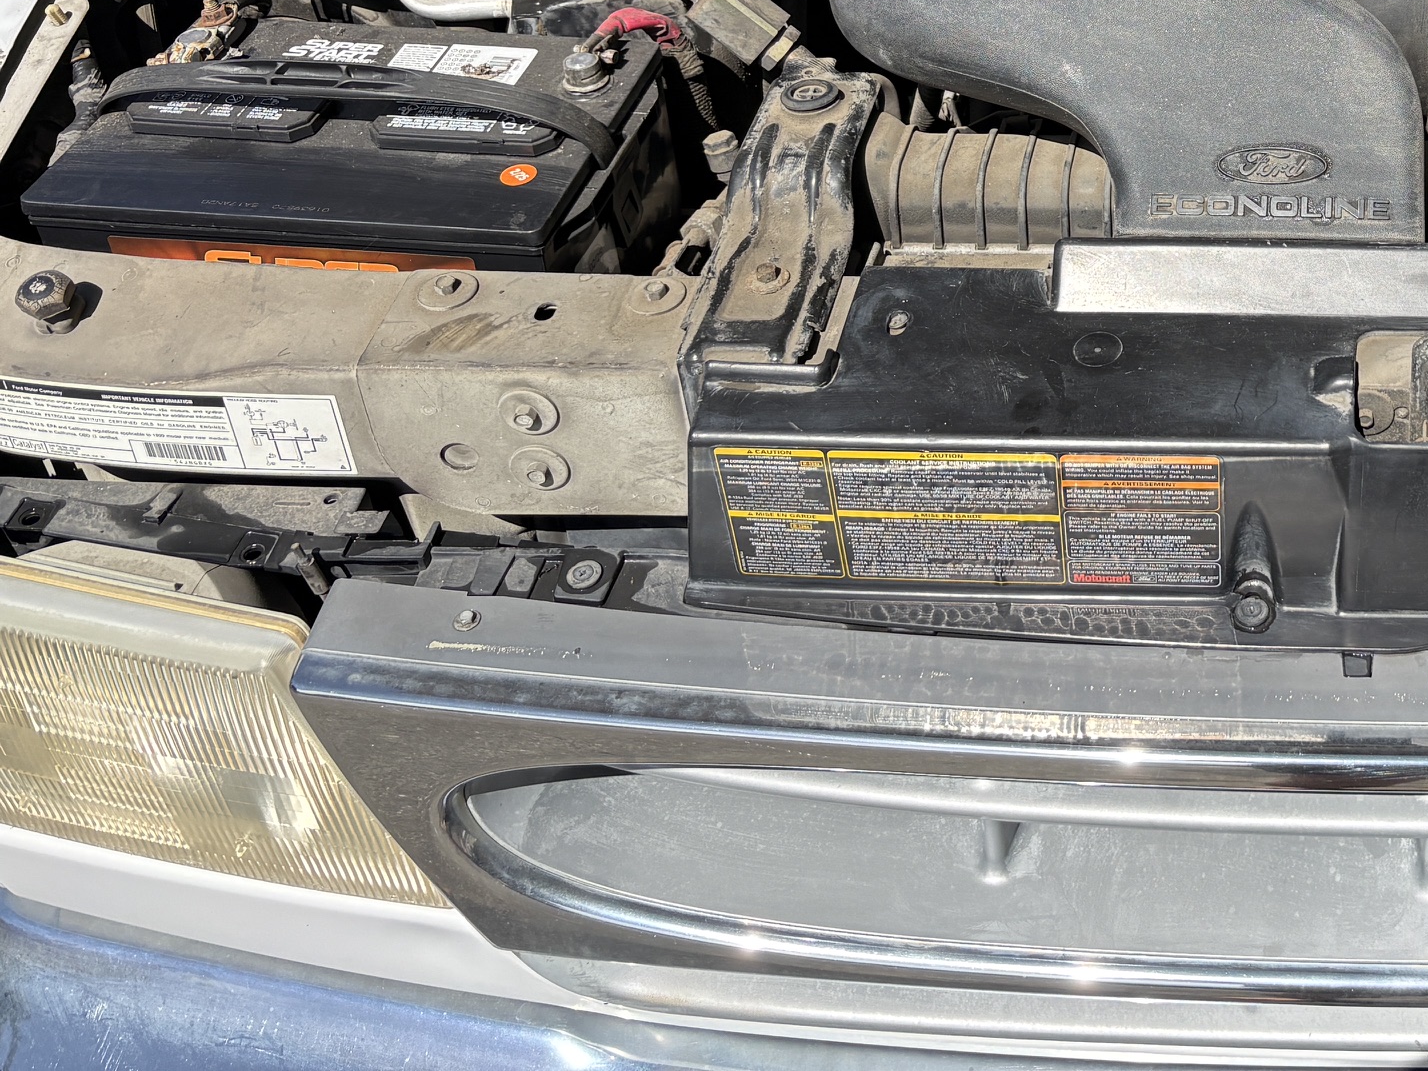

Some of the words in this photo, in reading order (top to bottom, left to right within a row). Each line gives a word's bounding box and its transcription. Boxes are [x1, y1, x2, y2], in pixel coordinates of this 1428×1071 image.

[304, 39, 385, 51] SUPER
[282, 45, 379, 59] START
[1239, 149, 1307, 179] Ford
[1149, 192, 1391, 222] ECONOLINE
[39, 388, 62, 396] Company
[12, 438, 44, 451] Catalyst
[1073, 573, 1131, 584] Motorcraft
